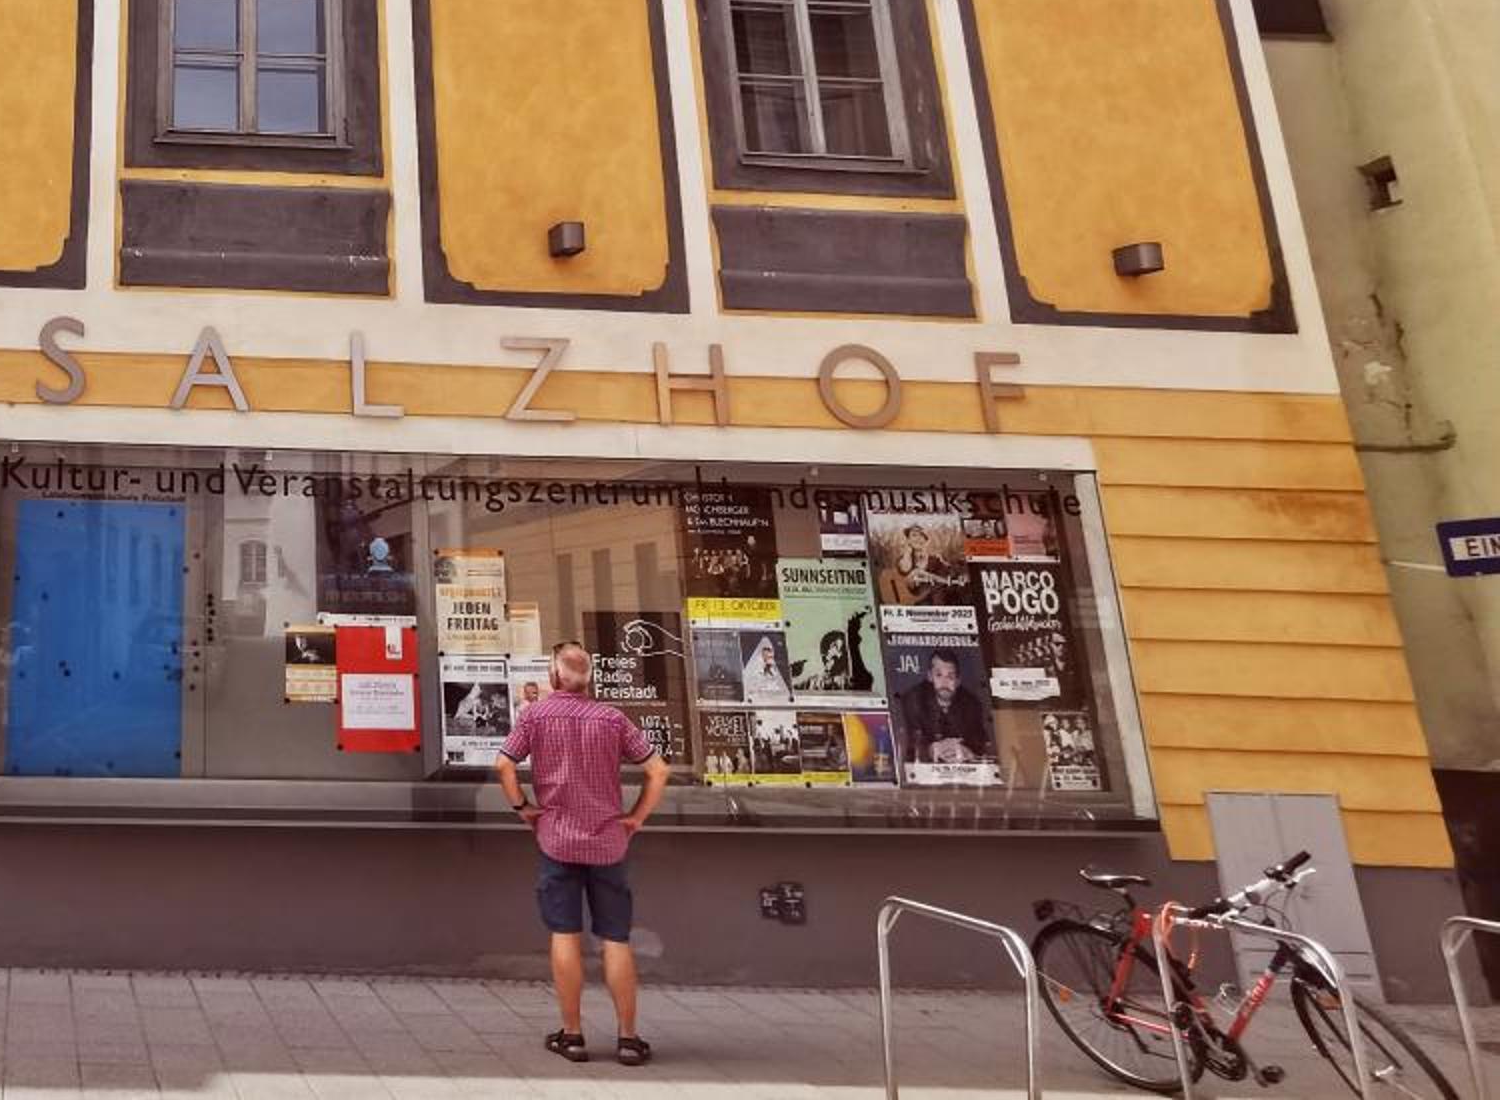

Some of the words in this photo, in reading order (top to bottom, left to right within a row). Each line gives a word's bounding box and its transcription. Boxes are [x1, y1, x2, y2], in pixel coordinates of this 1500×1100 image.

[1, 456, 142, 492] Kultur-
[156, 463, 224, 495] und
[981, 571, 1055, 592] MARCO
[451, 601, 492, 615] JEDEN
[984, 588, 1060, 615] POGO
[447, 618, 499, 631] FREITAG
[591, 654, 637, 669] Freies
[593, 669, 634, 683] Radio
[595, 684, 659, 699] Freistadt
